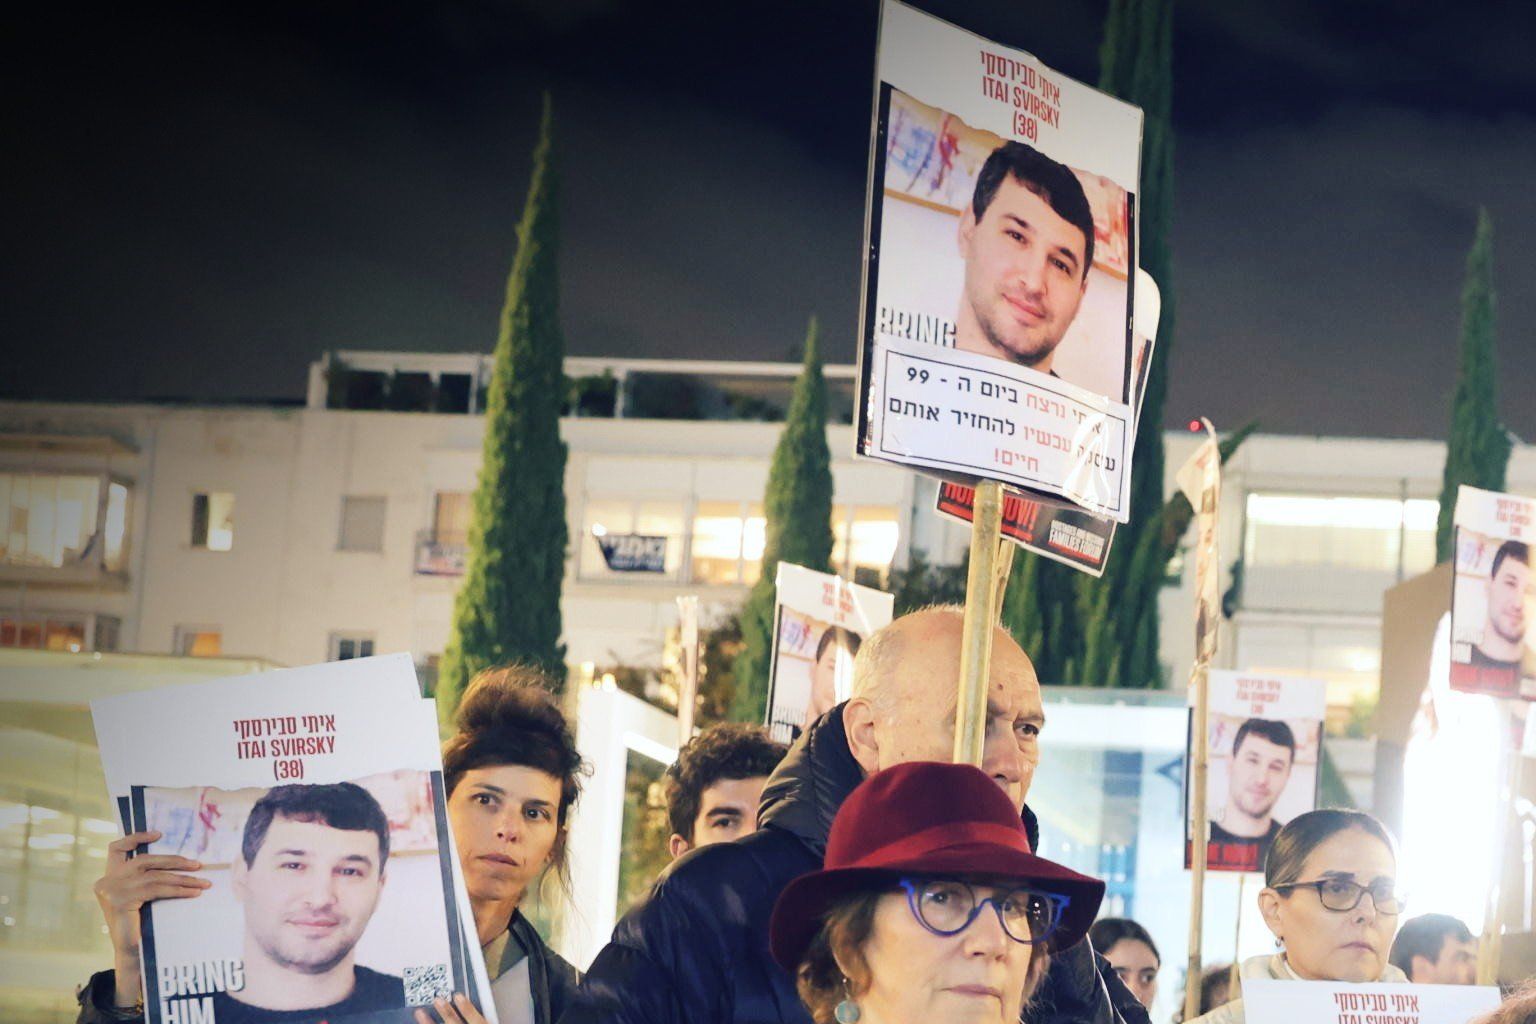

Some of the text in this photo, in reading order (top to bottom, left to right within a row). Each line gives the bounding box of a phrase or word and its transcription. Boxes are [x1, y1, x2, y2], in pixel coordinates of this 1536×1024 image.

[980, 50, 1061, 107] איתי סבירסקי
[982, 75, 1060, 129] ITAI SVIRSKY
[1013, 110, 1038, 144] (38)
[907, 367, 930, 384] 99
[958, 376, 971, 392] ה
[981, 381, 1018, 404] ביום
[889, 397, 940, 422] אותם
[1026, 392, 1066, 419] נרצח
[950, 409, 1016, 435] להחזיר
[1023, 424, 1072, 453] עכשיו
[993, 447, 1040, 472] חיים!
[233, 714, 336, 739] איתי סבירסקי
[237, 735, 335, 759] ITAI SVIRSKY
[273, 758, 304, 781] (38)
[159, 958, 245, 999] BRING
[1334, 992, 1420, 1013] איתי סבירסקי
